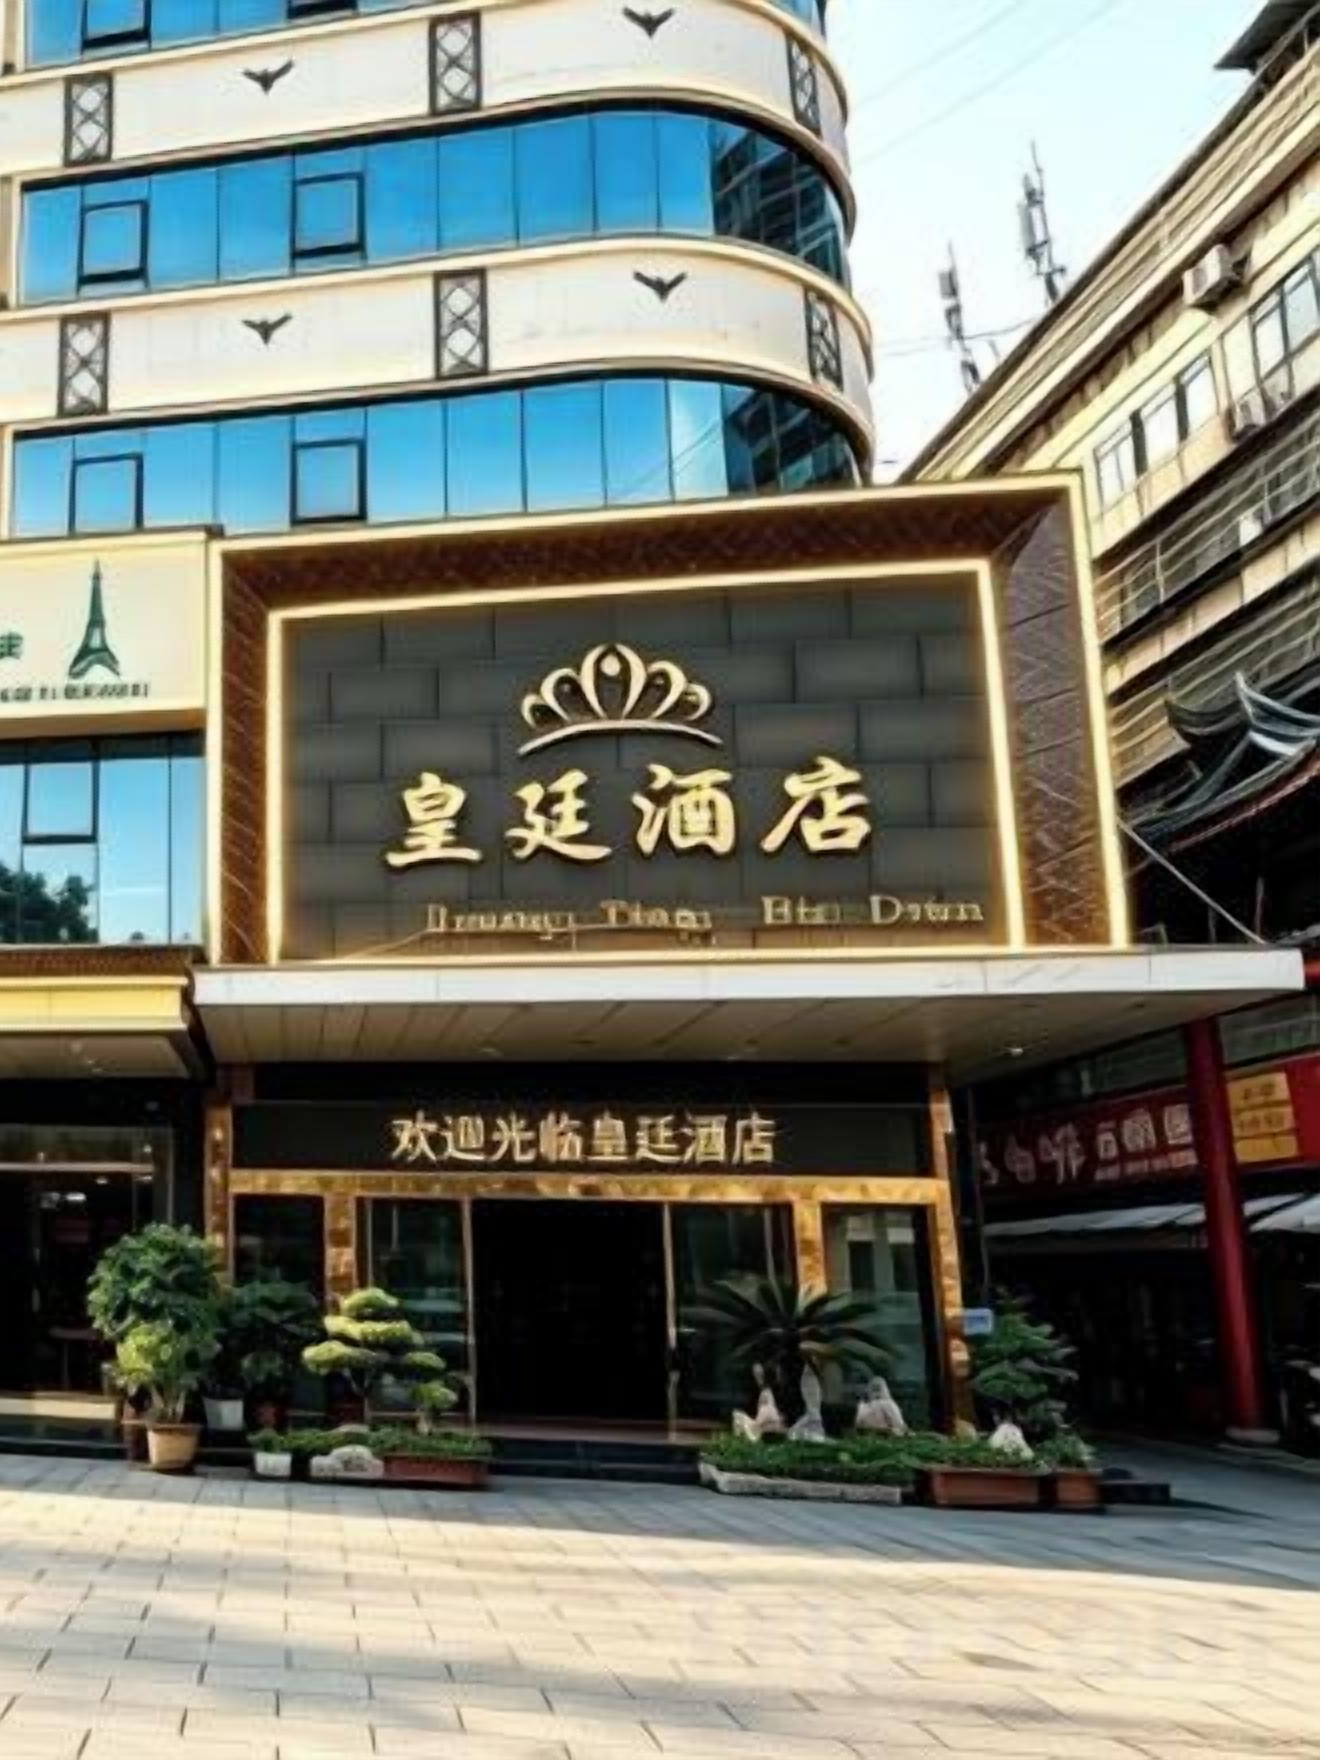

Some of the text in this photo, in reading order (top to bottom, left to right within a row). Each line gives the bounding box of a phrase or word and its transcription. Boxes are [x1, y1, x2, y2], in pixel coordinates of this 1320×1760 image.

[385, 756, 871, 867] 皇廷酒店
[391, 1109, 777, 1164] 欢迎光临皇廷酒店
